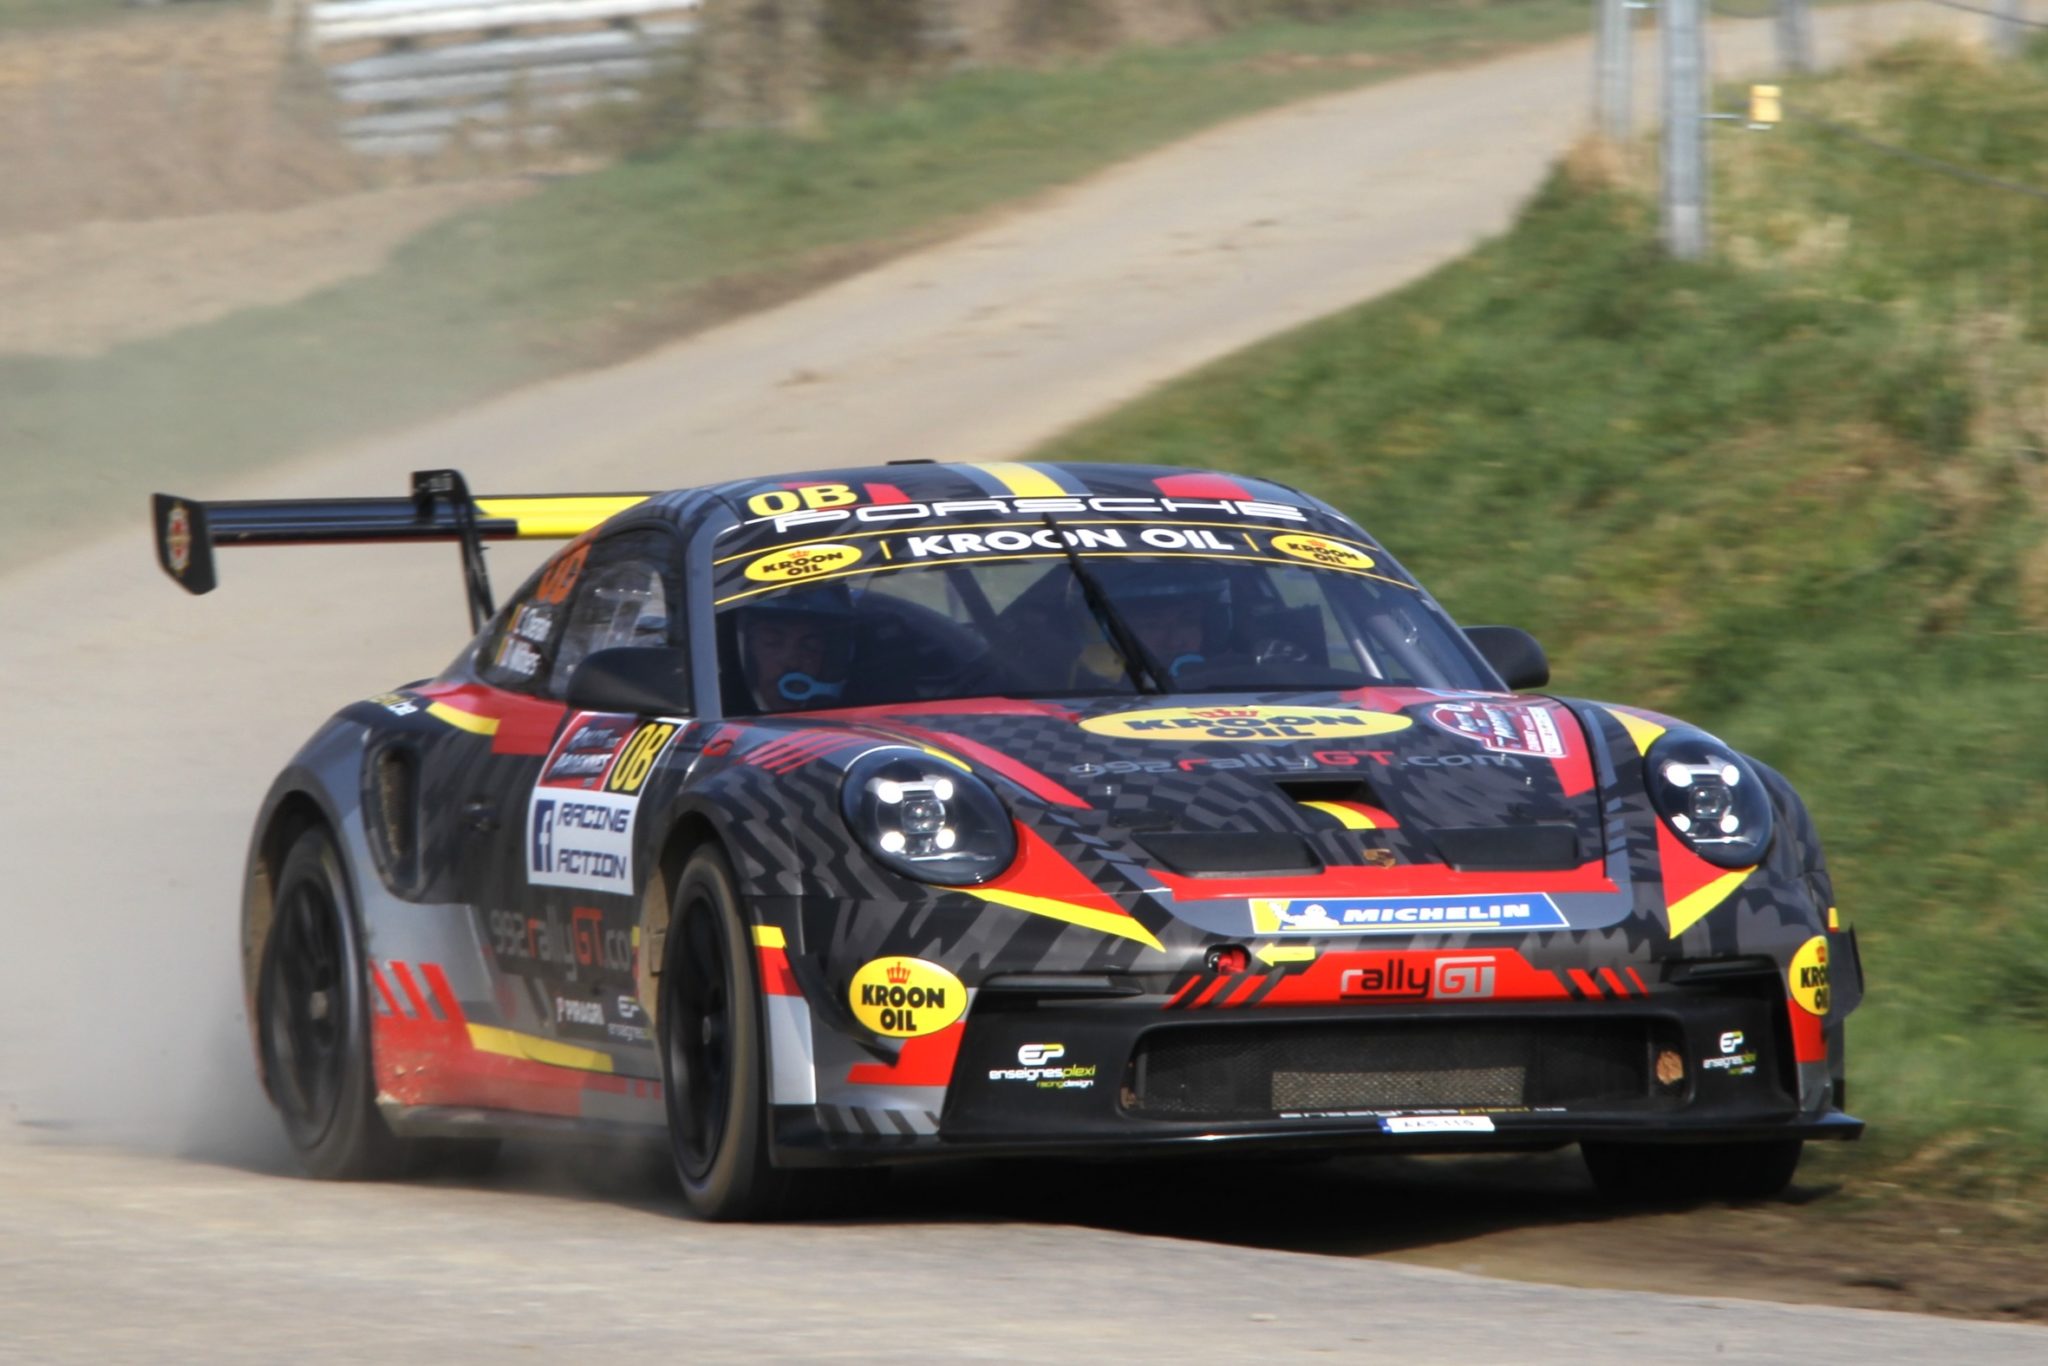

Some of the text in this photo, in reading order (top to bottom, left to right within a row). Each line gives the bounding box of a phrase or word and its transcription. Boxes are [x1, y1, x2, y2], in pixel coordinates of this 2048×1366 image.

[774, 498, 1308, 533] PORSCHE
[906, 528, 1235, 557] KROON OIL
[1286, 542, 1359, 562] KROON
[762, 552, 844, 573] KROON
[1312, 552, 1347, 564] OIL
[787, 564, 824, 576] OIL
[1123, 715, 1368, 731] KROON
[1205, 726, 1316, 738] OIL
[556, 802, 631, 833] RACING
[556, 848, 627, 880] ACTION
[1343, 904, 1531, 922] MICHELIN
[1340, 955, 1496, 999] rallyGT
[861, 984, 945, 1009] KROON
[880, 1009, 917, 1032] OIL
[1018, 1044, 1065, 1066] EP
